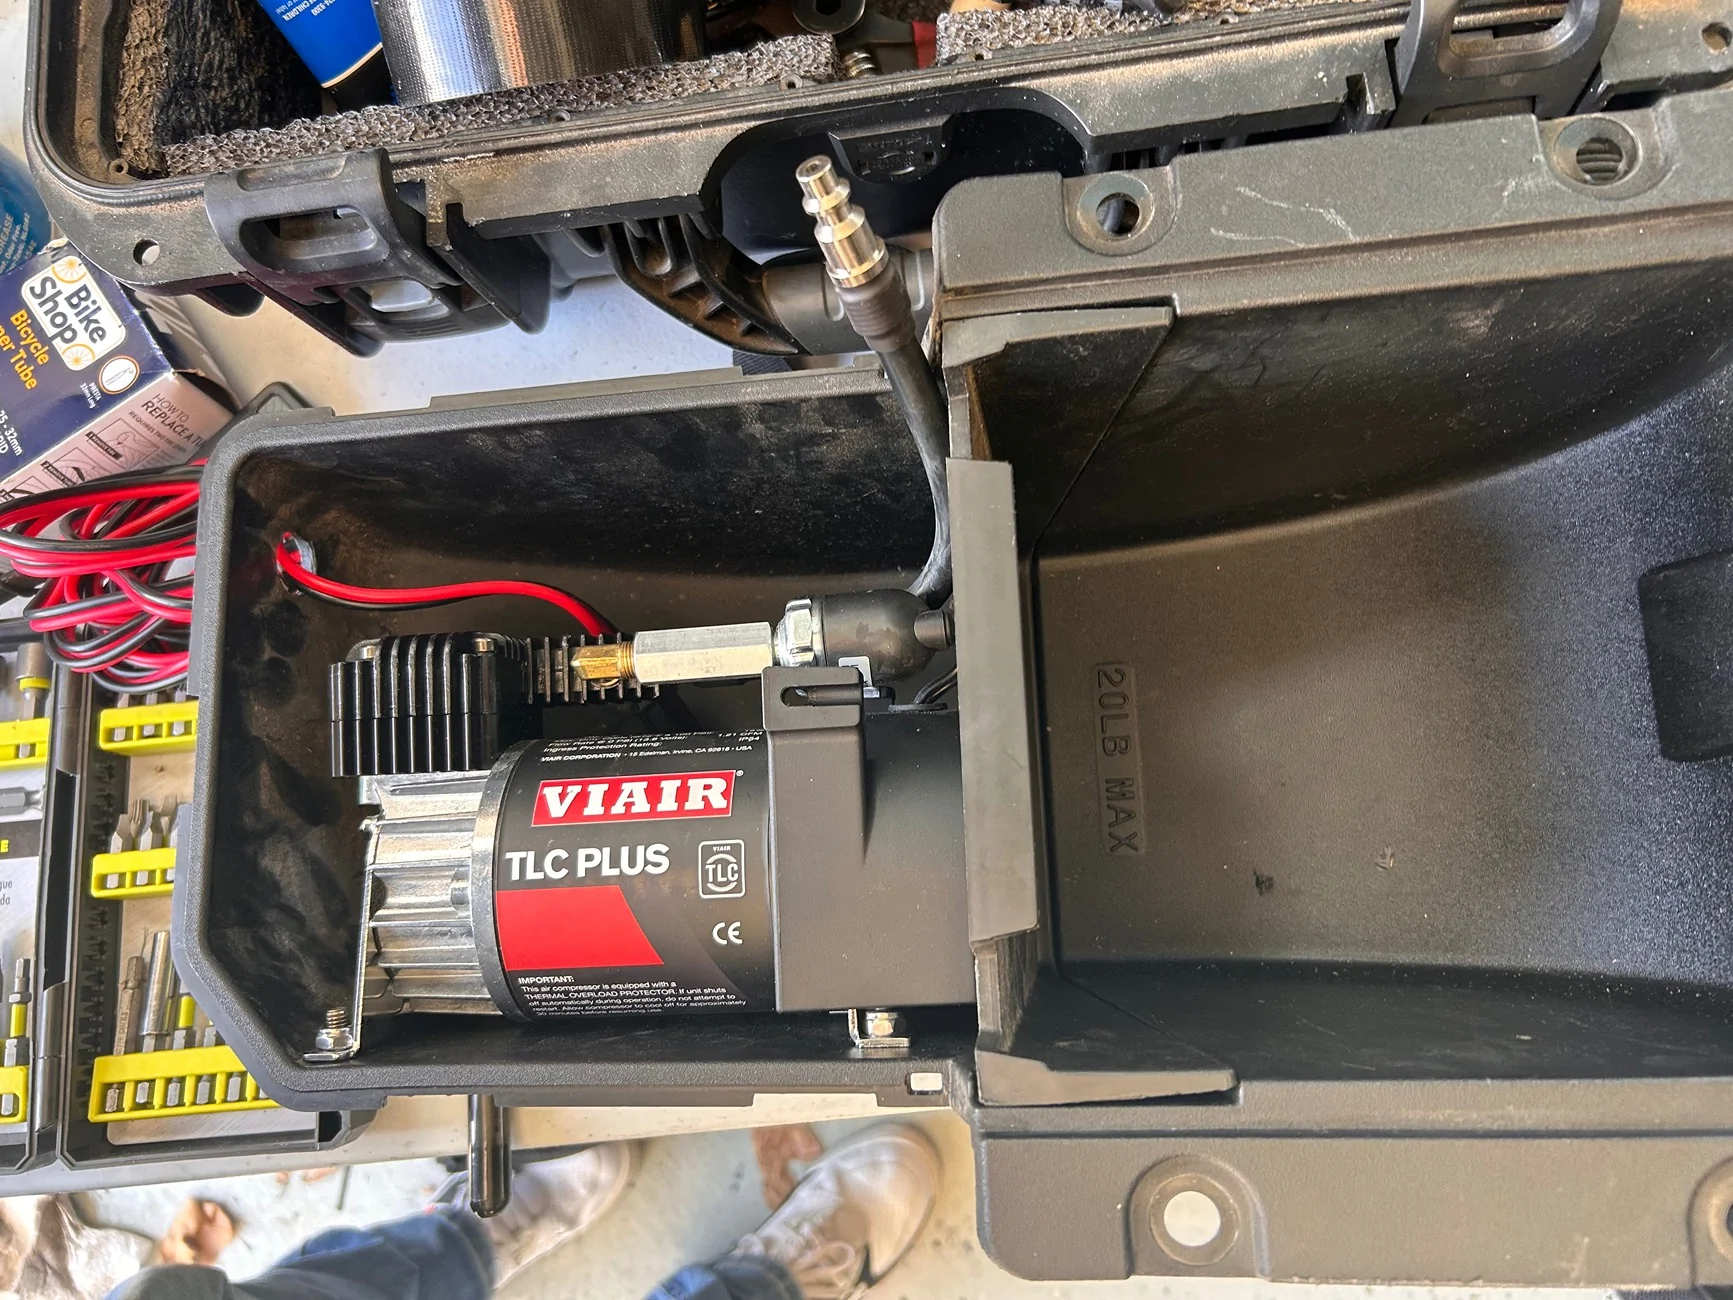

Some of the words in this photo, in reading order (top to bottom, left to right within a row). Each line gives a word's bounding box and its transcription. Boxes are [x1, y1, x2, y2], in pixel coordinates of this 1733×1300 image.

[30, 276, 78, 345] Shop
[63, 284, 106, 344] Bike
[10, 310, 49, 365] Bicycle
[10, 348, 37, 390] Tube
[89, 382, 101, 401] PRESTA
[128, 410, 155, 434] REQUIRES
[141, 400, 189, 437] REPLACE
[184, 432, 194, 442] A
[152, 394, 180, 415] HOW
[176, 410, 189, 423] TO
[5, 427, 22, 456] 32mm
[1098, 668, 1132, 757] 20LB
[542, 776, 728, 818] VIAIR
[1105, 777, 1139, 852] MAX
[505, 848, 569, 881] TLC
[576, 843, 670, 879] PLUS
[705, 863, 738, 882] TLC
[712, 922, 743, 944] CE
[518, 976, 574, 984] IMPORTANT:
[569, 990, 618, 999] OVERLOAD
[610, 982, 650, 990] equipped
